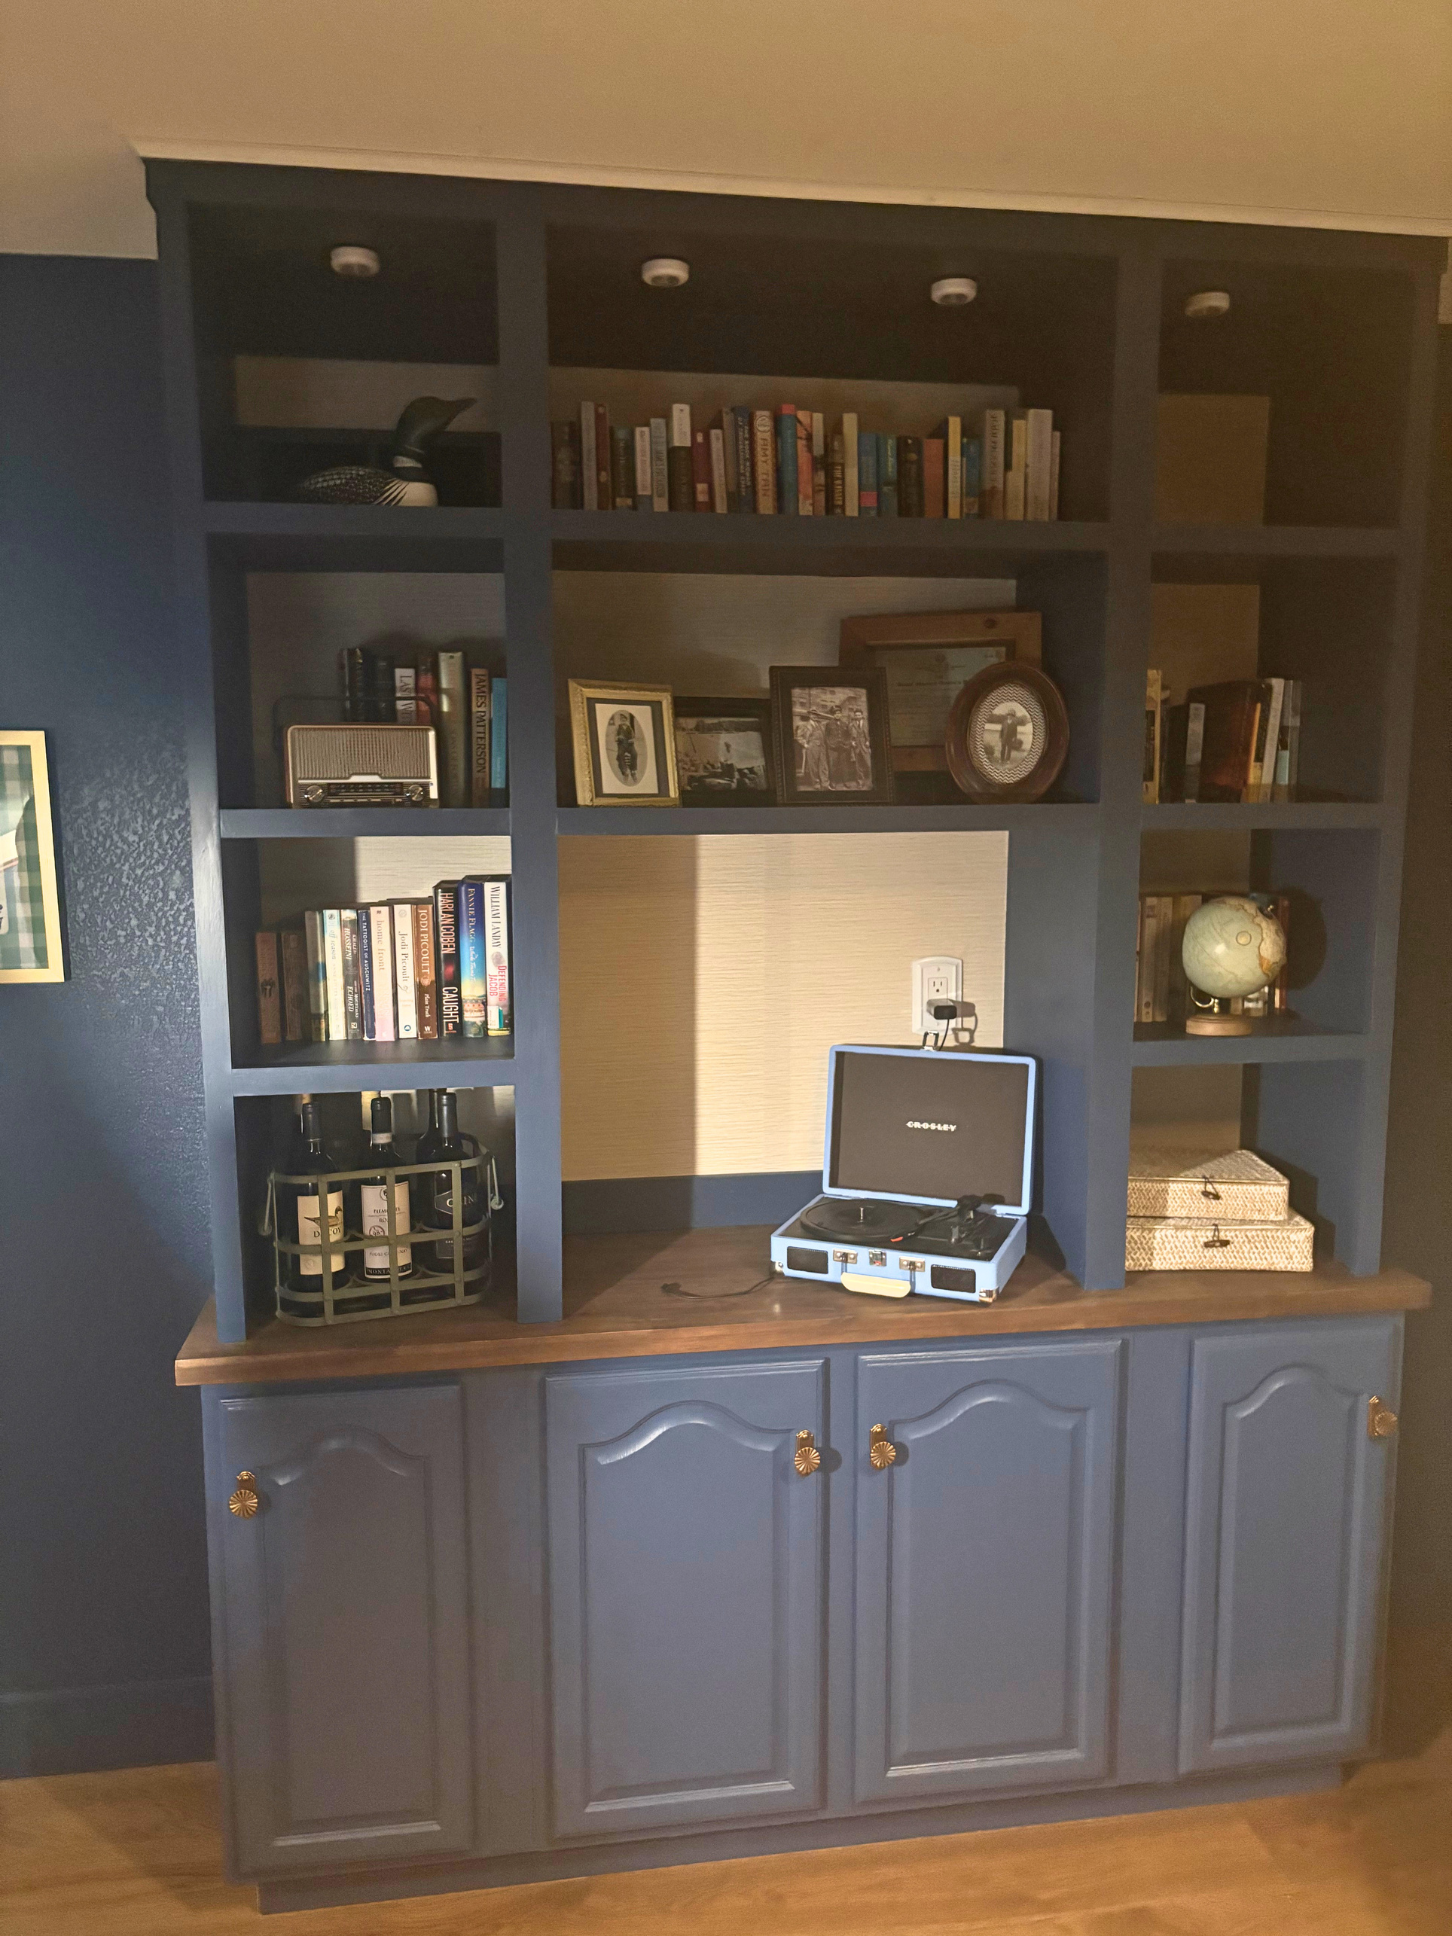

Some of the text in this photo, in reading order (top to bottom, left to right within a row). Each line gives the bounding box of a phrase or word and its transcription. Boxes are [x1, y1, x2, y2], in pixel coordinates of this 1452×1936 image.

[760, 438, 770, 498] AMY TAN
[475, 674, 486, 708] JAMES
[476, 710, 486, 774] PATTERSON
[440, 892, 456, 954] HARLAN COBEN
[468, 888, 477, 943] FANNIE FLAGG
[490, 886, 502, 948] WILLIAM LANDAY
[344, 928, 352, 960] HOSSEINI
[376, 920, 386, 971] home front
[398, 931, 410, 982] Jodi Picoult
[418, 909, 430, 974] JODI PICOULT
[442, 986, 459, 1023] CAUGHT
[488, 974, 498, 997] JACOB
[498, 966, 508, 1002] DEFENDING
[906, 1120, 957, 1132] CROSLEY
